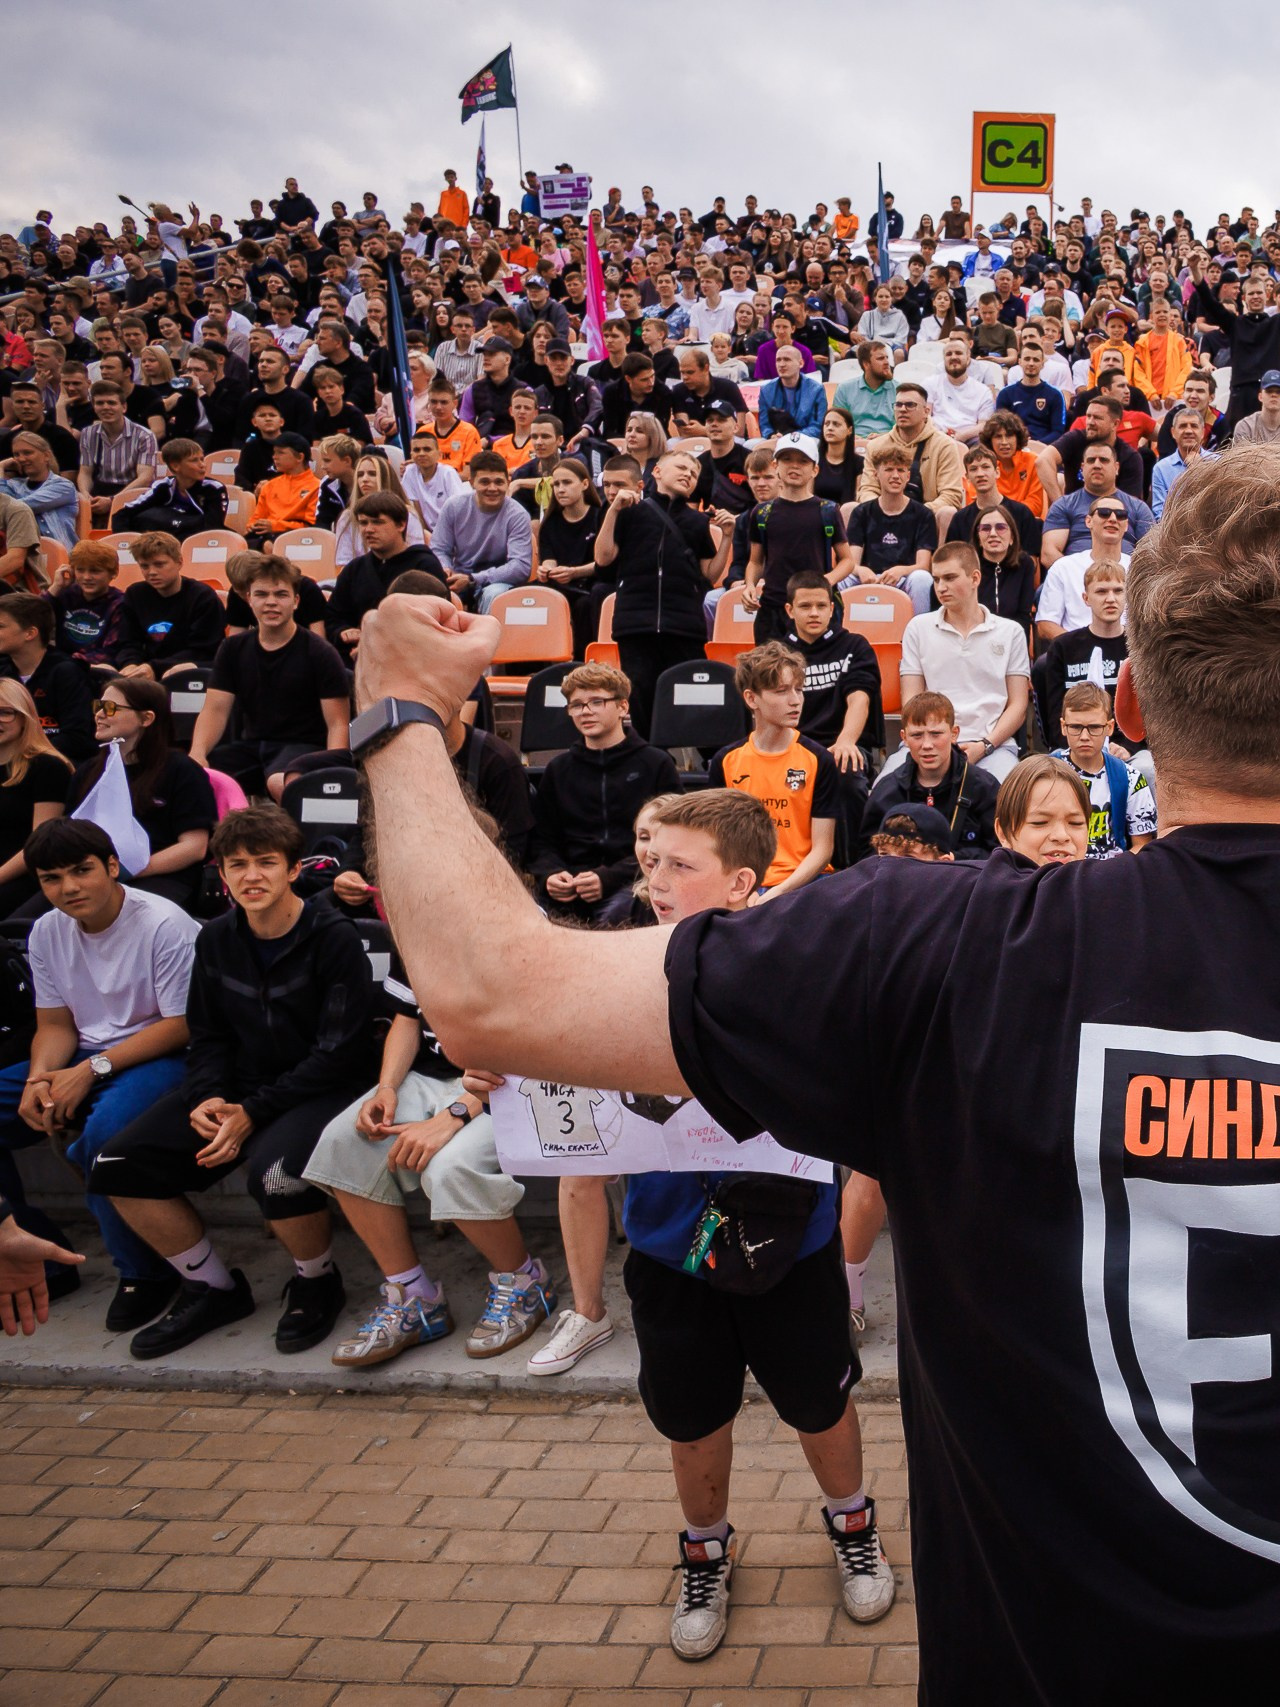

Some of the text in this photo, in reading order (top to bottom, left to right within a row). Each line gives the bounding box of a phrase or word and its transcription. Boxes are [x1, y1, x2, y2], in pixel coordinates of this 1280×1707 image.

[987, 138, 1042, 169] C4
[763, 798, 788, 809] нтур
[557, 1100, 575, 1135] 3
